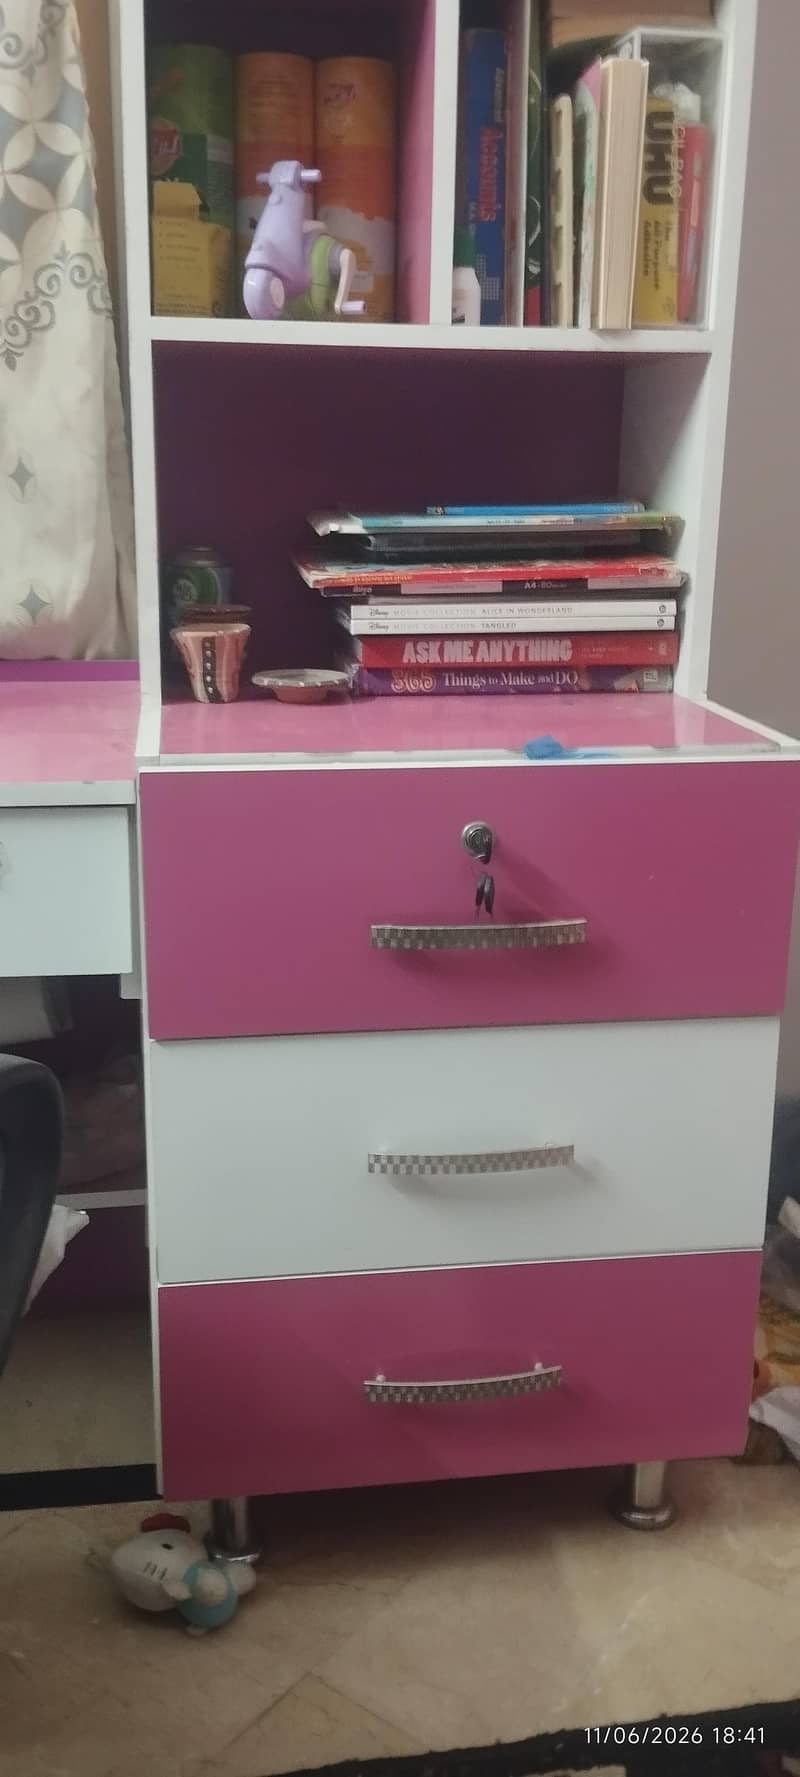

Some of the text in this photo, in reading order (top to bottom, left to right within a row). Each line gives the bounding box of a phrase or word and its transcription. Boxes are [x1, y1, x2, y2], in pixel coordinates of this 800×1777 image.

[641, 110, 676, 206] UHU
[480, 127, 503, 222] Accounts
[482, 607, 505, 615] ALICE
[507, 607, 515, 615] IN
[518, 606, 573, 615] WONDERLAND
[481, 621, 517, 630] TANGLED
[402, 640, 441, 664] ASK
[443, 639, 475, 664] ME
[476, 638, 573, 664] ANYTHING
[443, 672, 487, 688] Things
[488, 676, 498, 685] to
[500, 671, 536, 686] Make
[555, 670, 579, 686] DO
